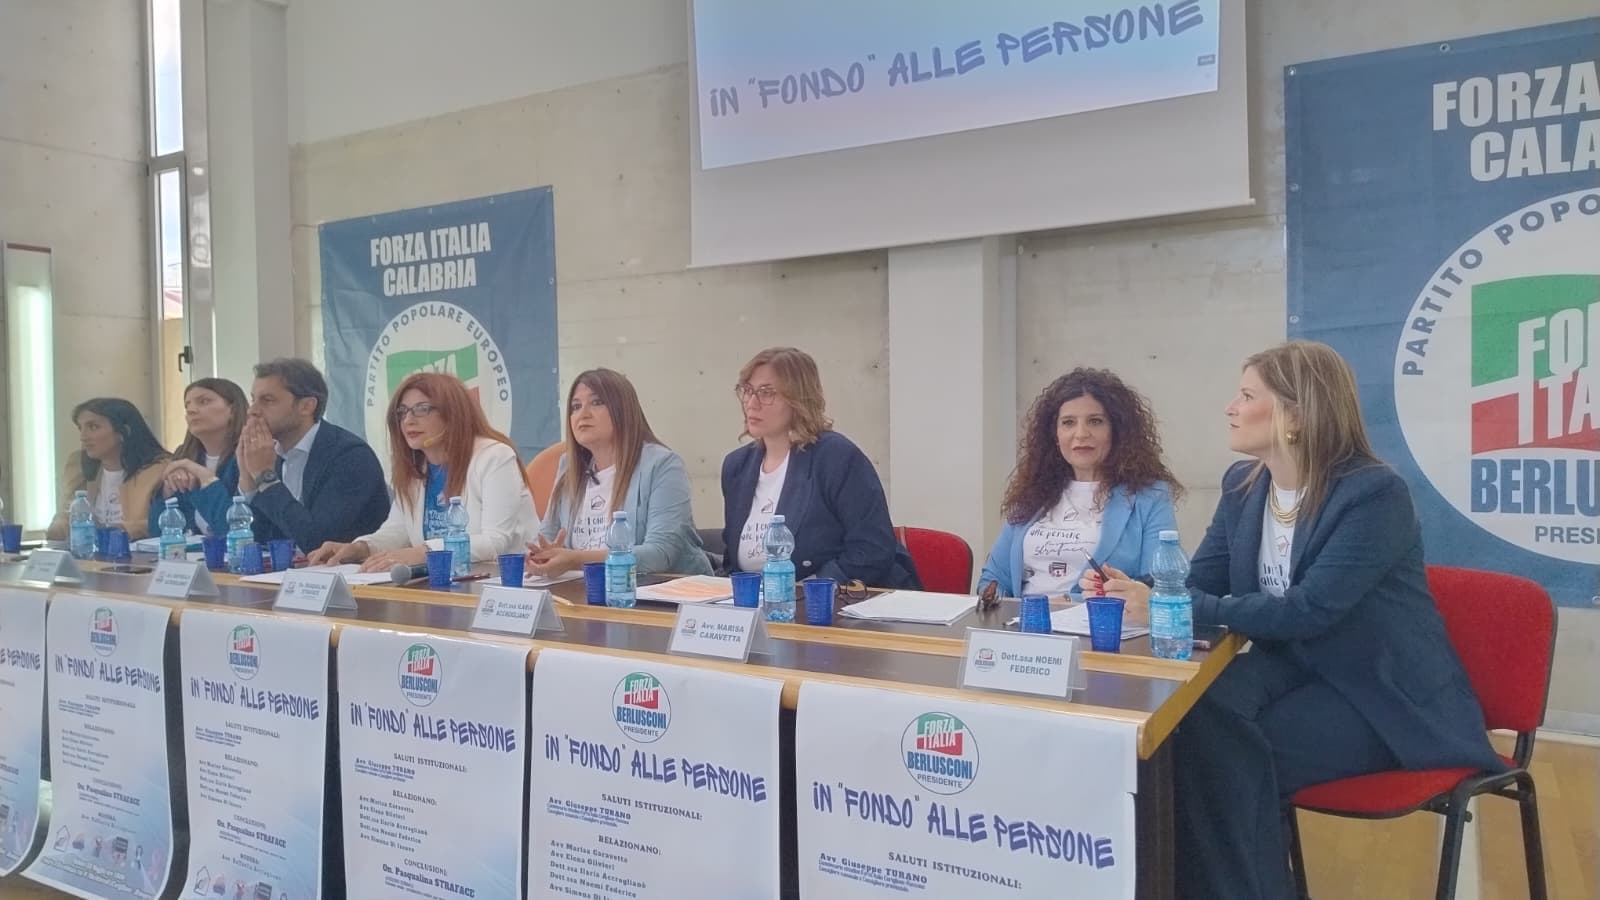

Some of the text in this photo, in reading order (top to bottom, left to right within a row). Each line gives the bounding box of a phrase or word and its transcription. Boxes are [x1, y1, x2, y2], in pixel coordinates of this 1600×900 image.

[887, 40, 985, 87] ALLE
[996, 0, 1204, 66] PERSONE
[1432, 61, 1600, 131] FORZA
[370, 222, 491, 267] FORZA ITALIA
[383, 258, 477, 297] CALABRIA
[1402, 249, 1483, 375] PARTITO
[366, 304, 508, 407] PARTITO POPOLARE EUROPEO
[699, 631, 742, 643] CARAVETTA
[717, 624, 745, 634] MARISA
[99, 662, 123, 684] ALLE
[1010, 664, 1050, 676] FEDERICO
[1035, 656, 1063, 665] NOEMI
[630, 678, 654, 692] FORZA
[240, 685, 266, 711] ALLE
[267, 690, 320, 720] PERSONE
[616, 706, 667, 729] BERLUSCONI
[923, 717, 955, 735] FORZA
[413, 713, 447, 741] ALLE
[450, 718, 516, 753] PERSONE
[624, 725, 659, 737] PRESIDENTE
[922, 733, 956, 751] ITALIA
[631, 749, 677, 784] ALLE
[682, 758, 767, 803] PERSONE
[907, 751, 973, 781] BERLUSCONI
[917, 774, 963, 789] PRESIDENTE
[601, 793, 631, 806] SALUTI
[600, 807, 631, 820] TURANO
[927, 801, 988, 843] ALLE
[993, 814, 1115, 869] PERSONE
[395, 867, 433, 886] Pasqualina
[434, 878, 475, 898] STRAFACE
[841, 858, 882, 874] Giuseppe
[885, 868, 928, 884] TURANO
[888, 851, 1022, 890] SALUTI ISTITUZIONALI:
